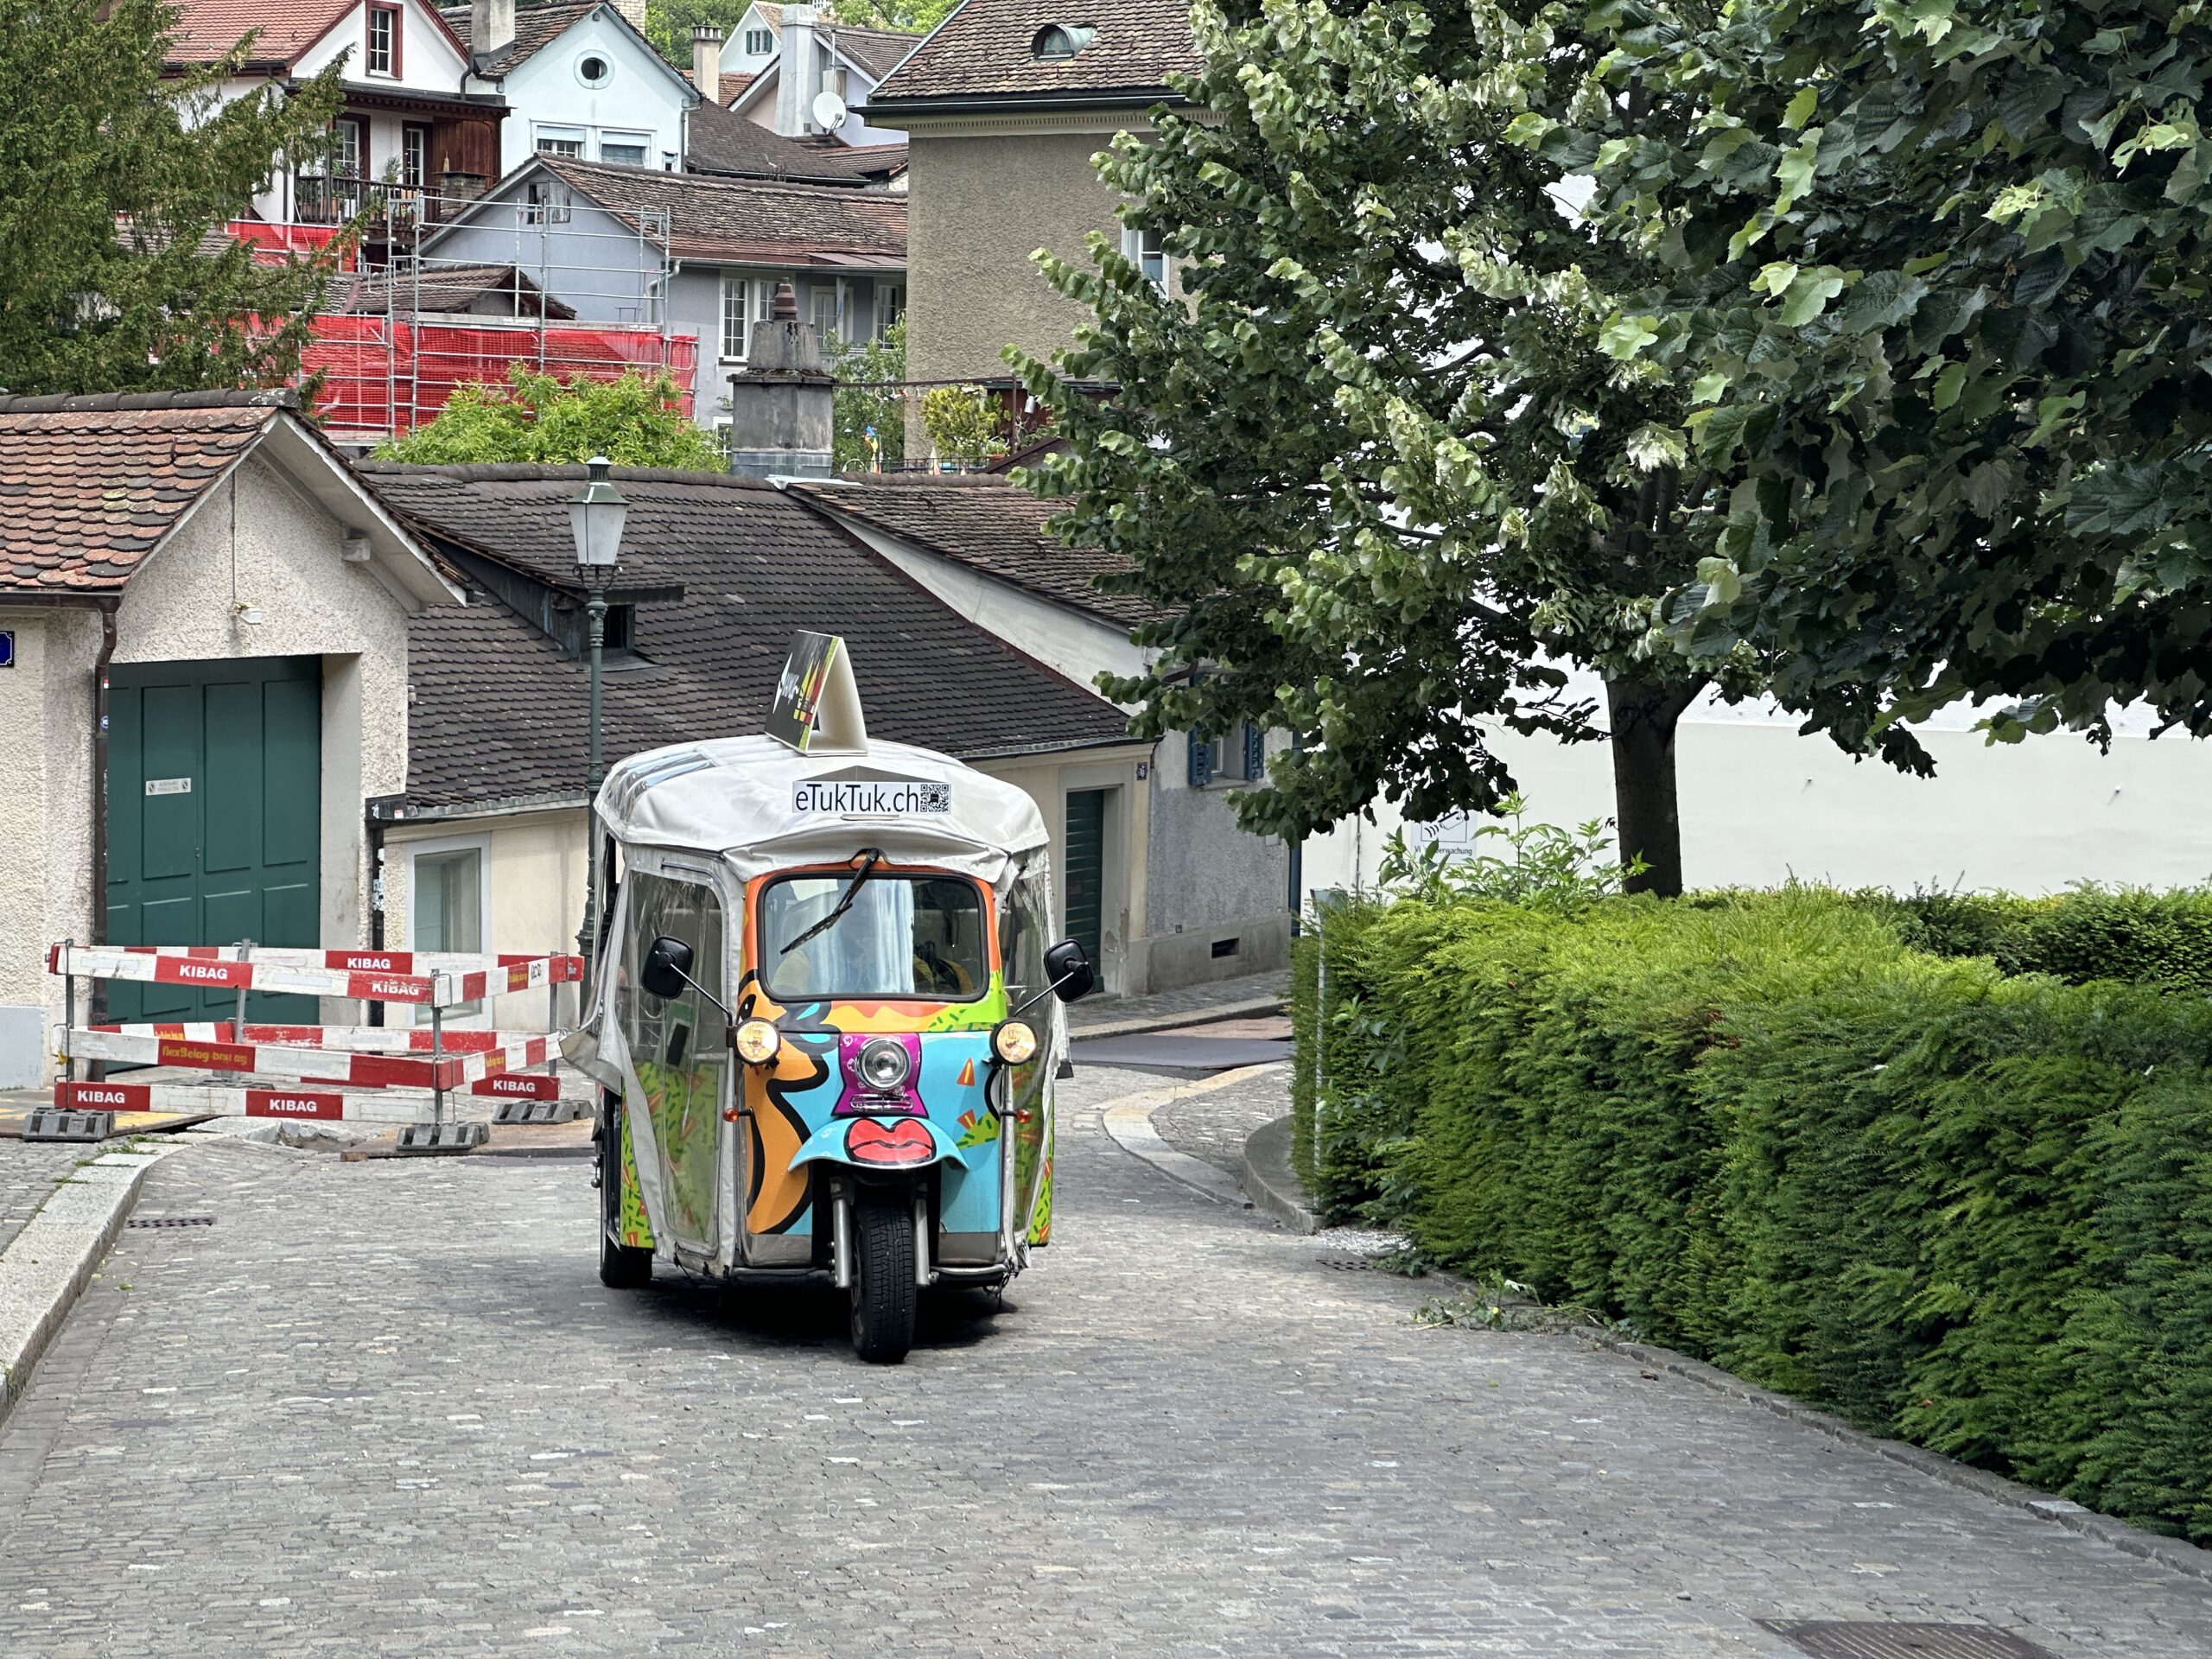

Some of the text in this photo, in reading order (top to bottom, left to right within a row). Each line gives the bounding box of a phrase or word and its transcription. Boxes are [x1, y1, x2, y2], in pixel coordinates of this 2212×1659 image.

[795, 783, 918, 812] eTukTuk.ch
[347, 957, 391, 969] KIBAG
[179, 965, 228, 980] KIBAG
[372, 980, 419, 995] KIBAG
[493, 1080, 536, 1092] KIBAG
[77, 1090, 125, 1103] KIBAG
[270, 1099, 317, 1112] KIBAG
